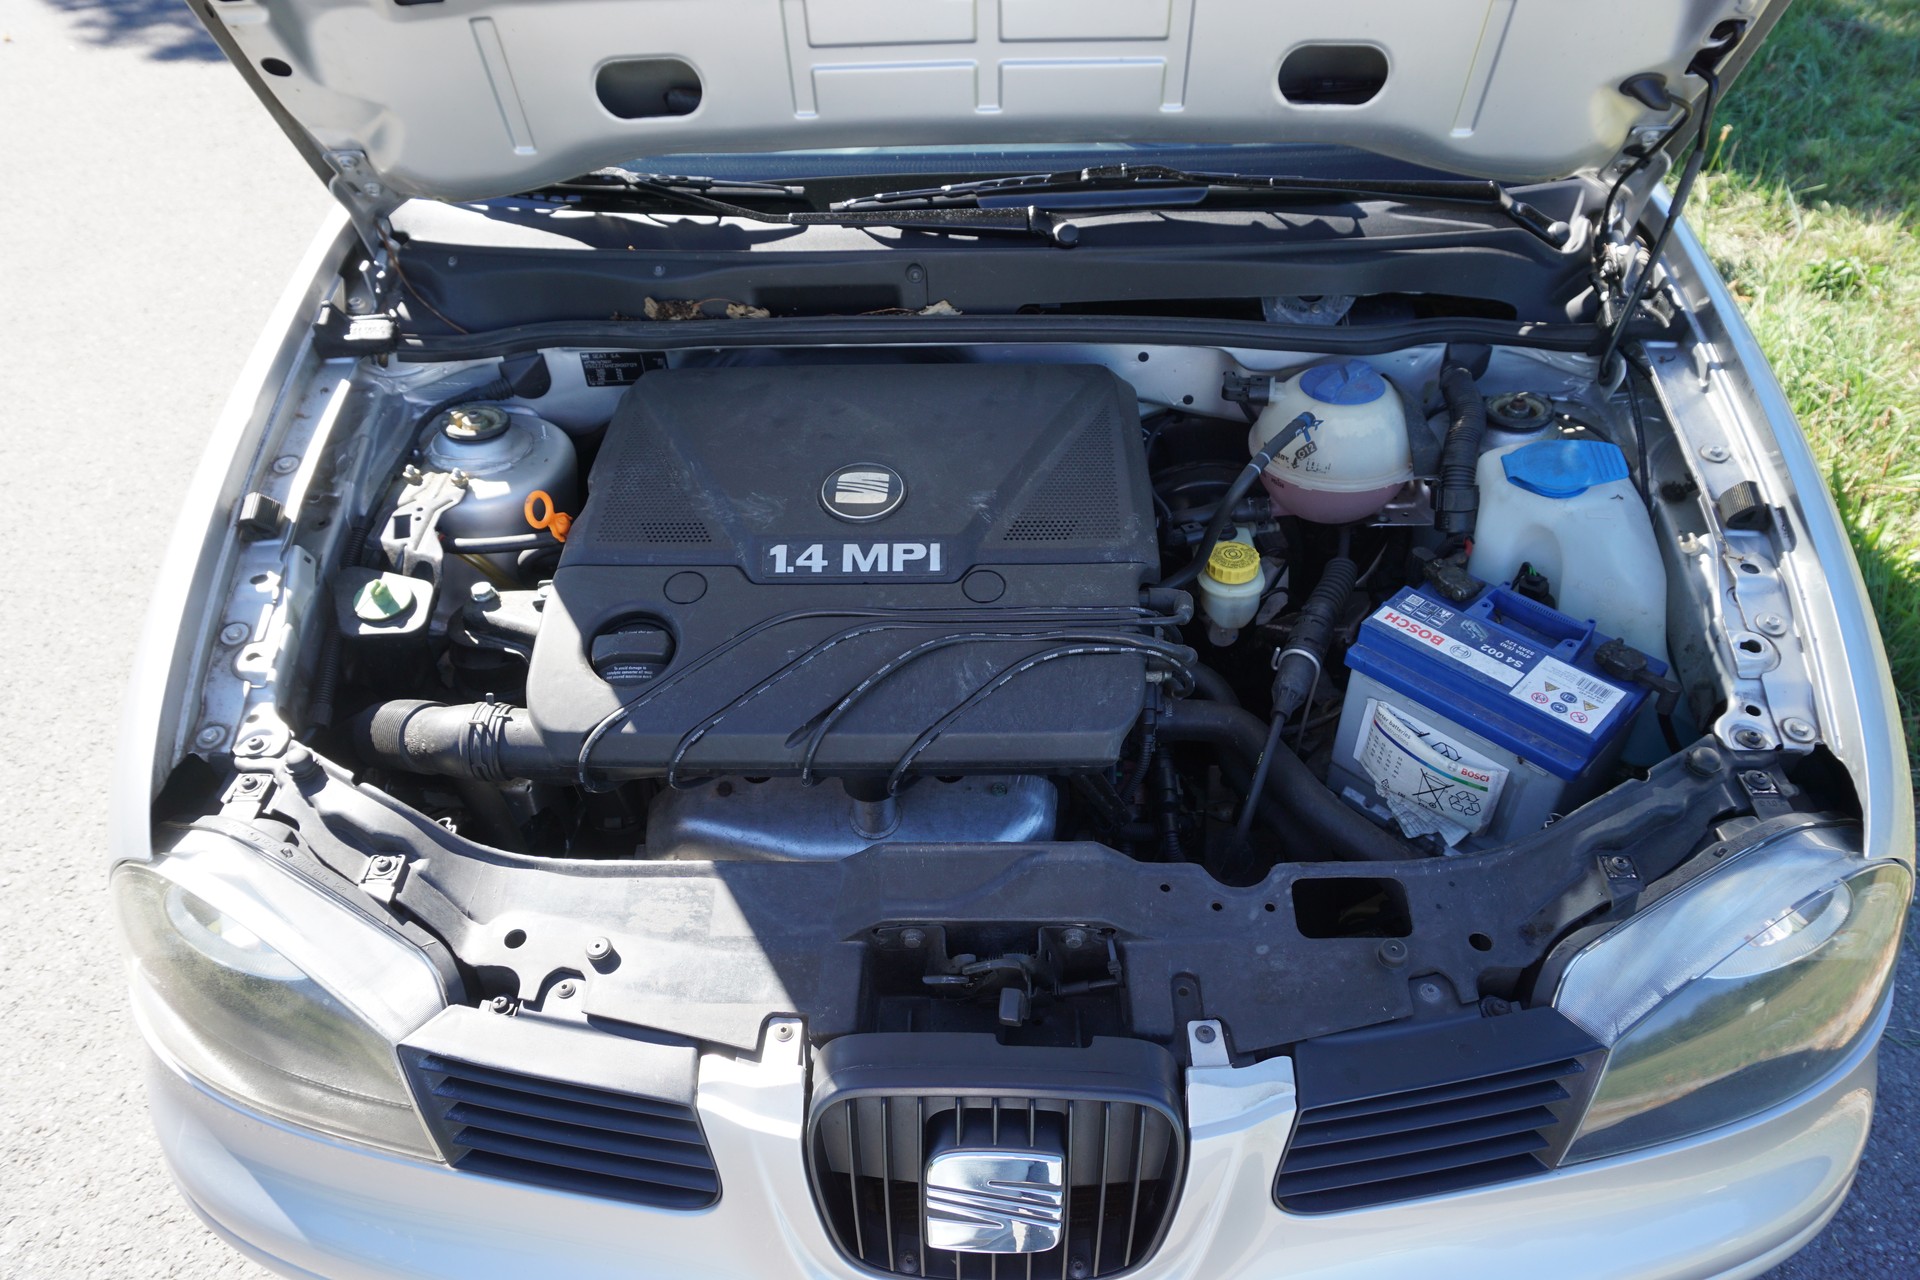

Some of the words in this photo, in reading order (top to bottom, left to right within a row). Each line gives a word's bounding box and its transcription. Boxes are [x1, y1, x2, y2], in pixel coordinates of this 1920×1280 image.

[1298, 443, 1316, 459] G12
[769, 544, 829, 573] 1.4
[842, 543, 941, 573] MPI
[1384, 612, 1446, 646] BOSCH
[1500, 642, 1515, 652] (EN)
[1504, 639, 1518, 648] 12V
[1480, 644, 1505, 658] 002
[1515, 649, 1532, 660] 470A
[1506, 656, 1524, 668] S4
[1389, 720, 1411, 740] batteries
